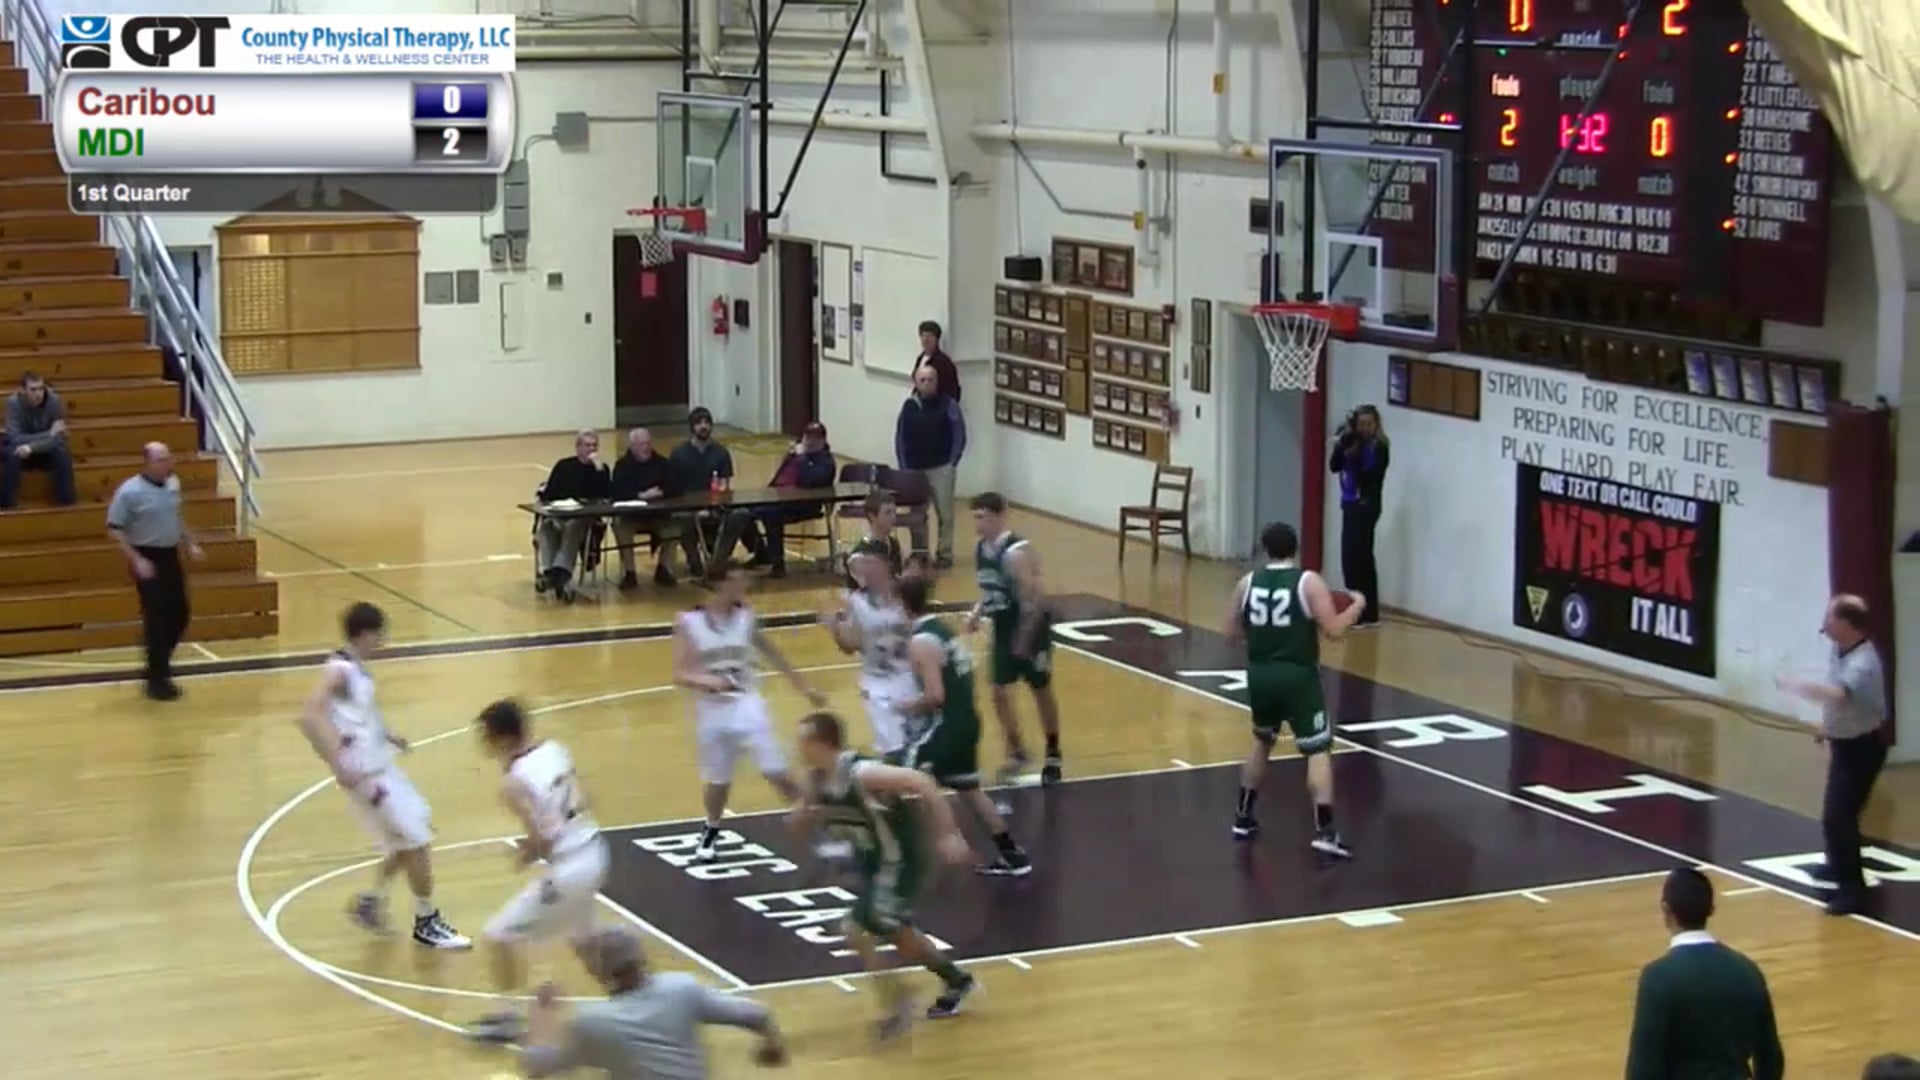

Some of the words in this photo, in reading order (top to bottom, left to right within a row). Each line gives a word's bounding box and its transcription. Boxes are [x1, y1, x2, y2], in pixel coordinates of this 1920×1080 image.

[1501, 108, 1518, 146] 2
[1650, 116, 1670, 157] 0
[1487, 370, 1568, 405] STRIVING
[1582, 386, 1618, 414] FOR
[1634, 395, 1769, 443] EXCELLENCE,
[1513, 406, 1615, 447] PREPARING
[1629, 428, 1665, 456] FOR
[1501, 436, 1546, 465] PLAY
[1629, 461, 1678, 492] PLAY
[1539, 470, 1566, 495] ONE
[1567, 475, 1599, 502] TEXT
[1601, 482, 1618, 506] OR
[1619, 487, 1651, 512] CALL
[1652, 495, 1698, 522] COULD
[1541, 500, 1697, 601] WRECK
[1250, 586, 1292, 627] 52
[1631, 596, 1655, 634] IT
[1654, 602, 1694, 646] ALL
[632, 828, 799, 881] BIG
